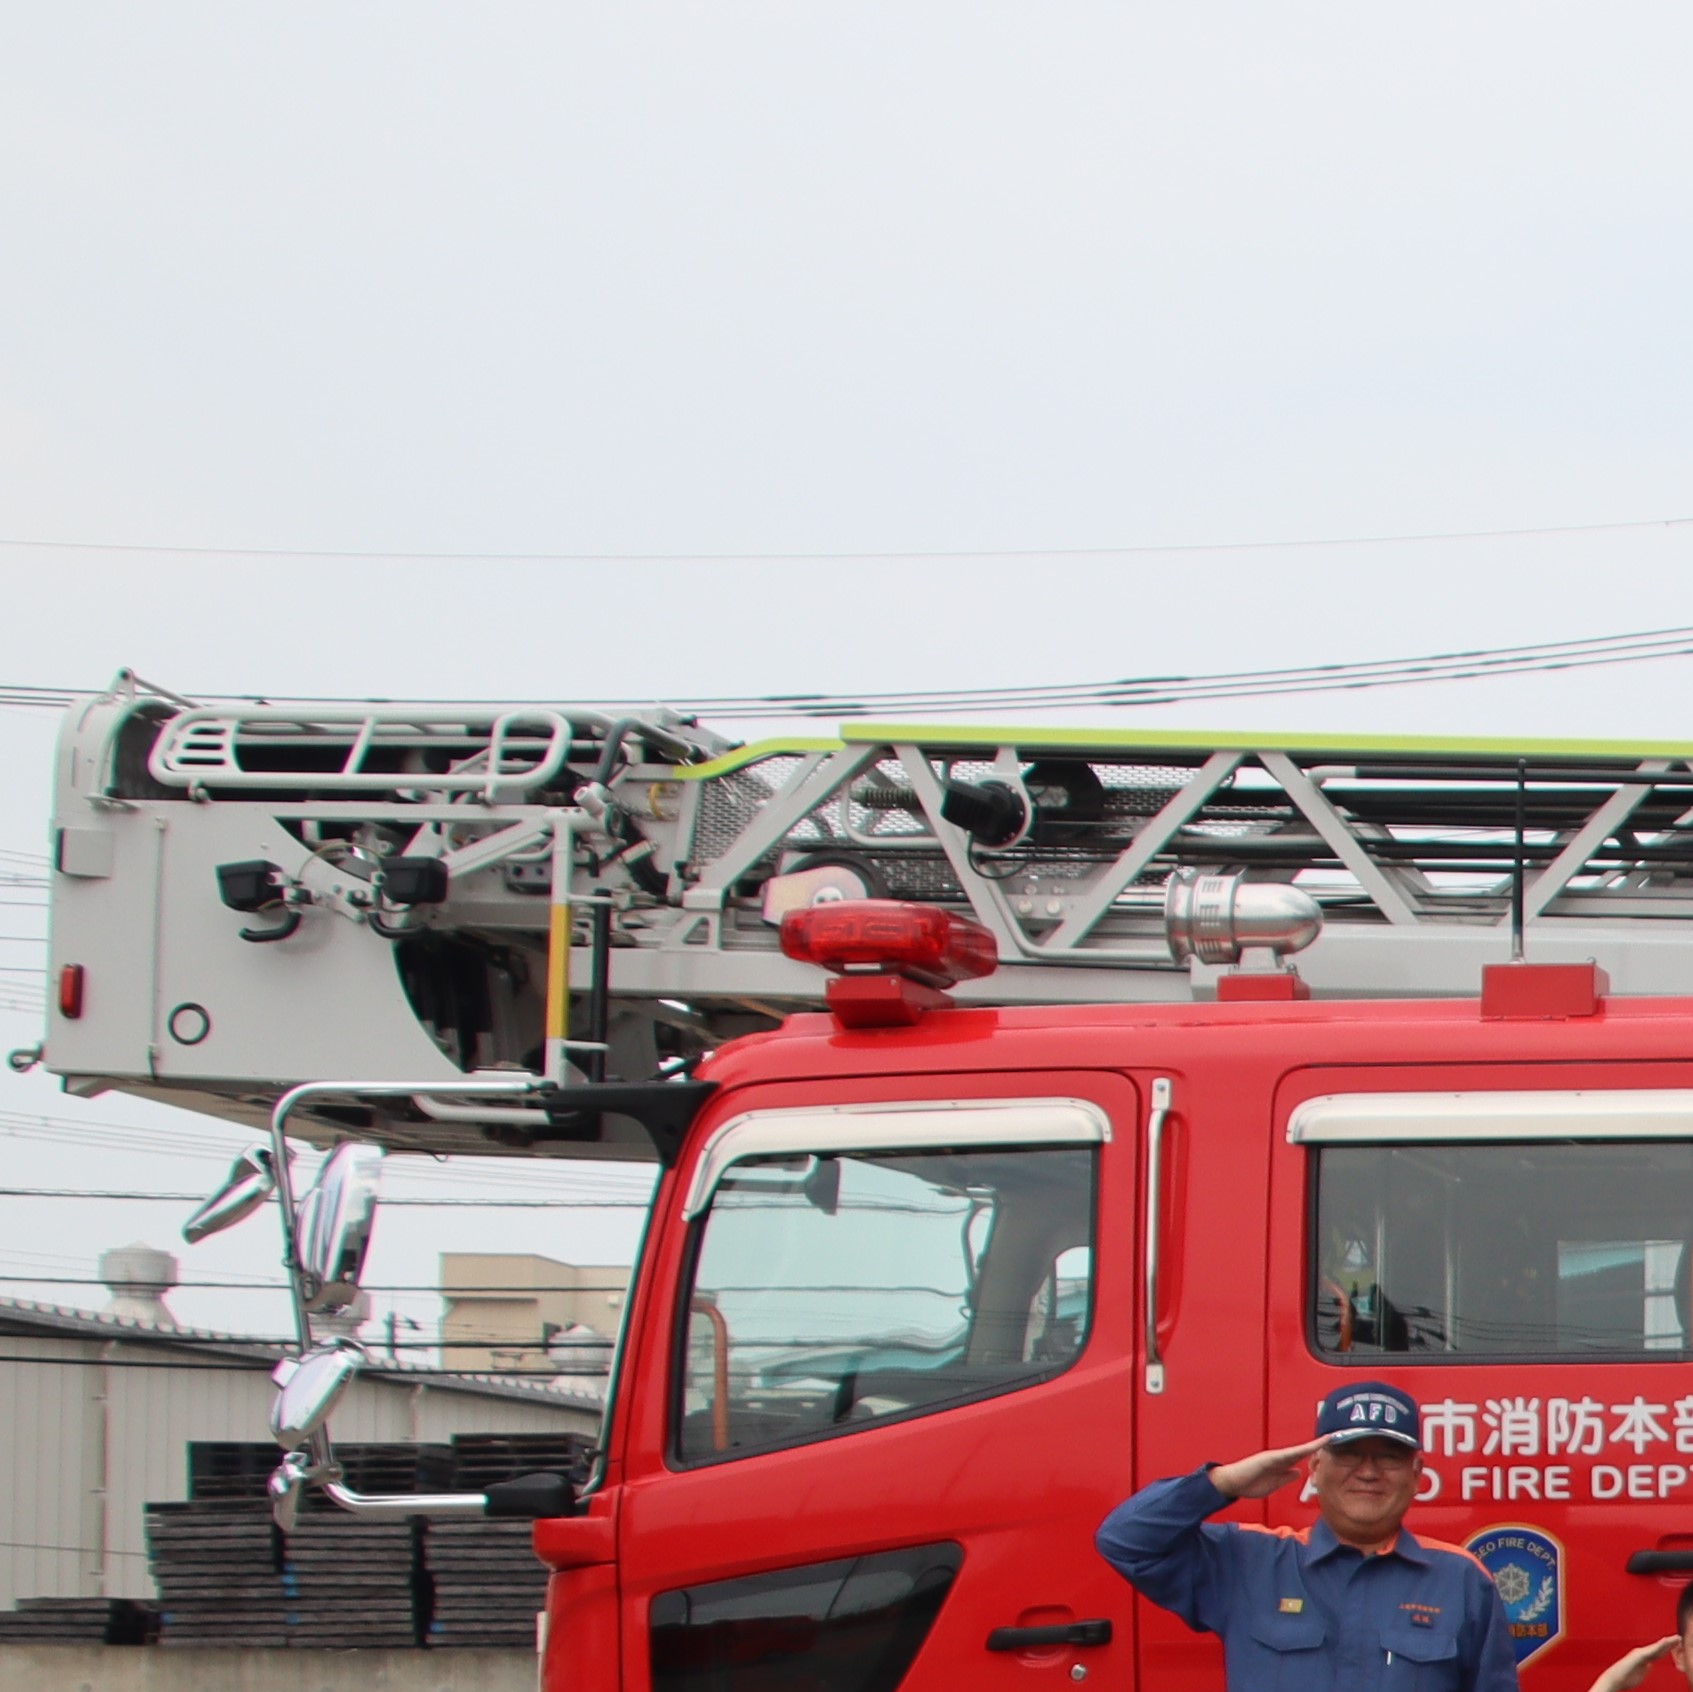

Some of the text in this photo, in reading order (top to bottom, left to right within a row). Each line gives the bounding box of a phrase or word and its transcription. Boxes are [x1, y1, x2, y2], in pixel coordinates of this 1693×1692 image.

[1350, 1403, 1397, 1423] AFD
[1461, 1466, 1571, 1500] FIRE
[1498, 1537, 1525, 1548] FIRE
